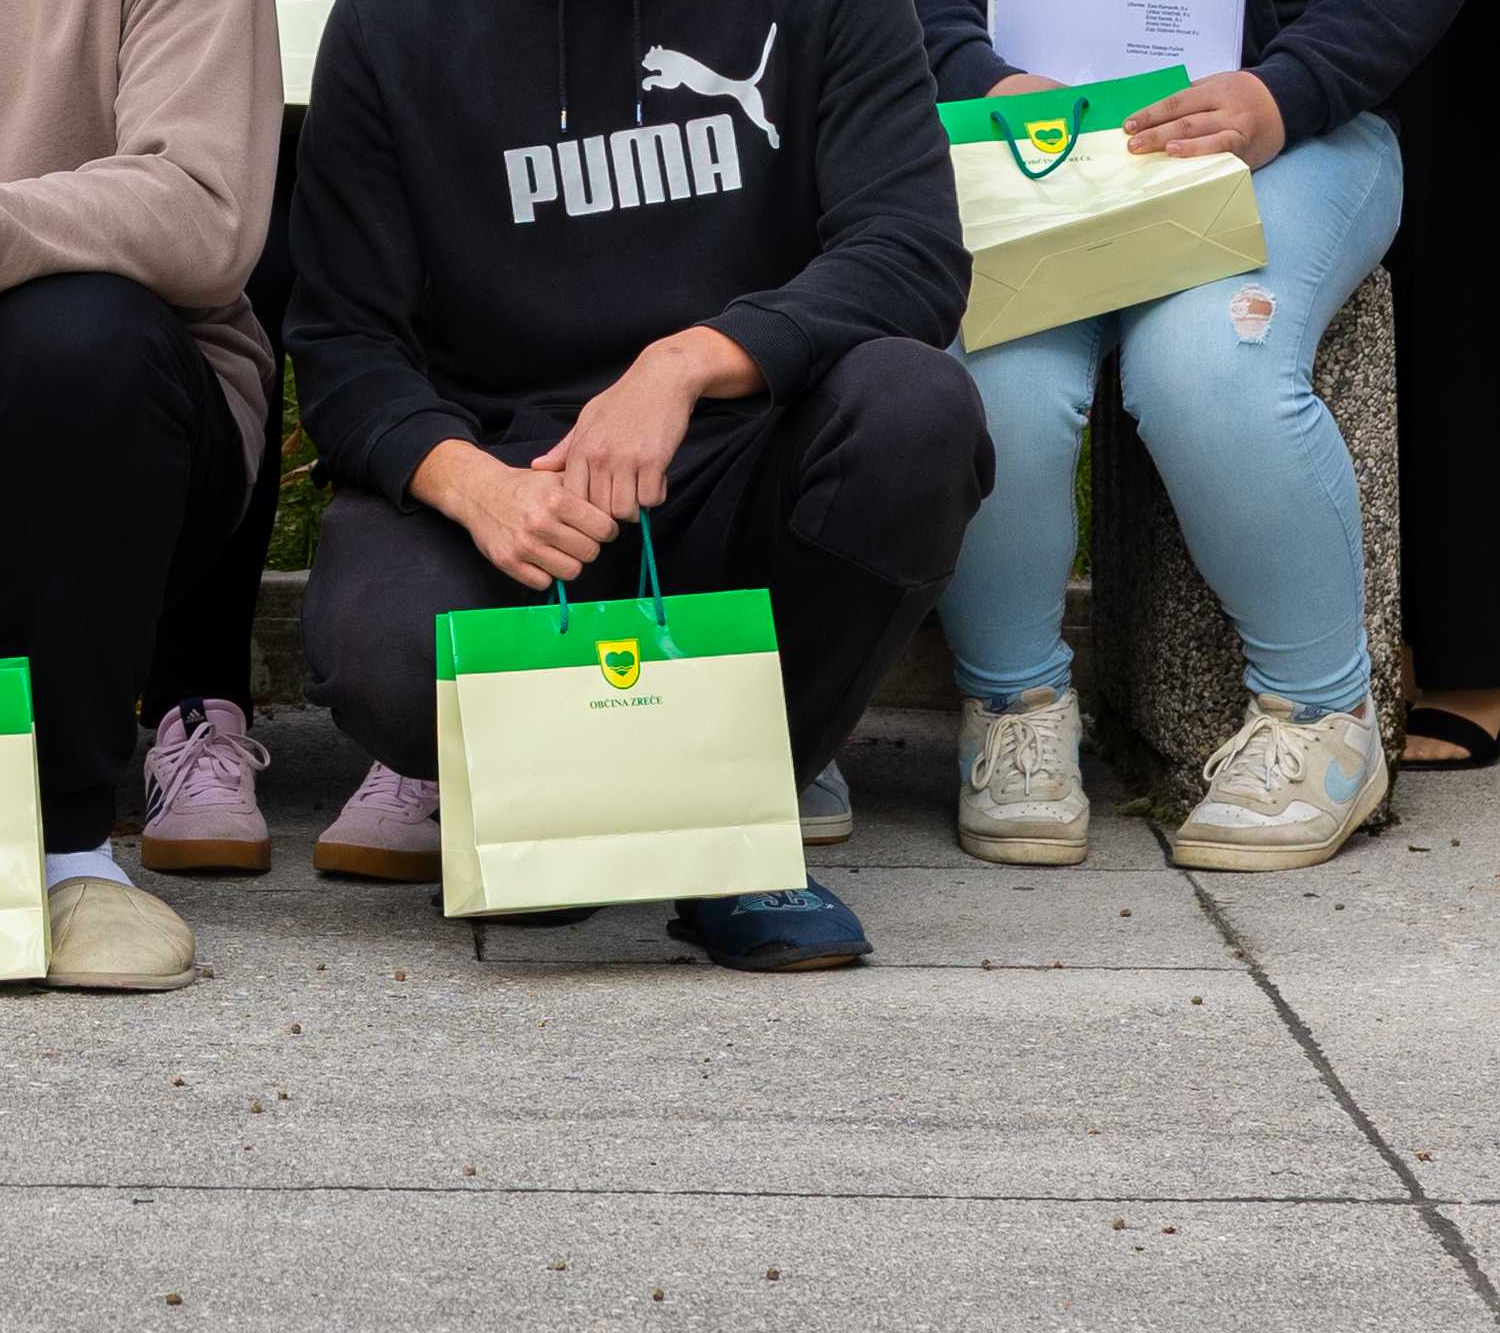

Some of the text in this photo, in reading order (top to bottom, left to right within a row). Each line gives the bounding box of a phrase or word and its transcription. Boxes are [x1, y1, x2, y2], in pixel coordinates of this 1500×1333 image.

[503, 113, 743, 224] PUMA
[589, 694, 663, 710] OBČINA ZREČE
